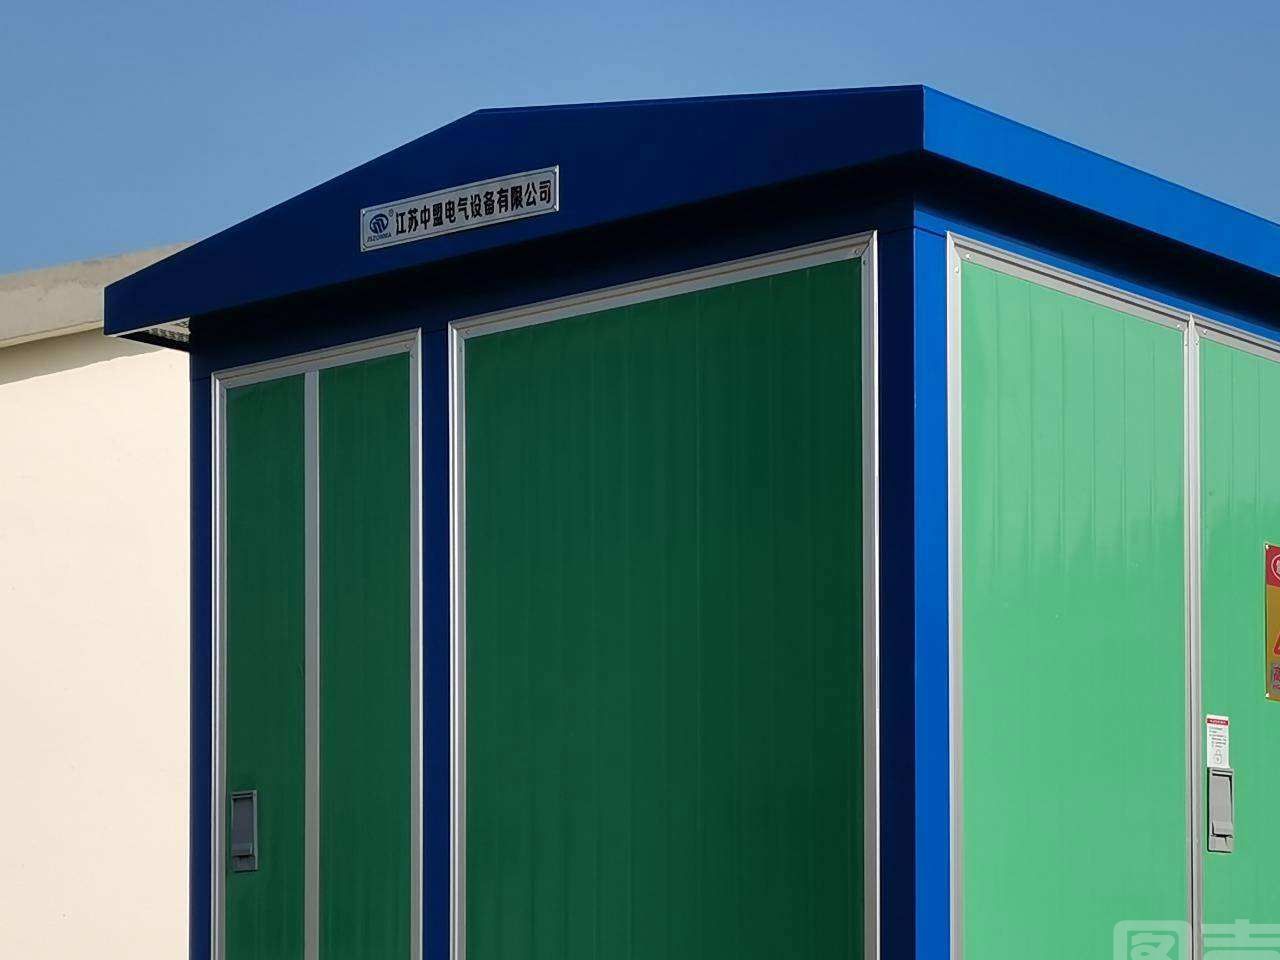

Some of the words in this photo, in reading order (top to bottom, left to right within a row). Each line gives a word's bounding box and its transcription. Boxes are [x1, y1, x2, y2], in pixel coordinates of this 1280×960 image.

[395, 179, 552, 236] 江苏中盟电气设备有限公司
